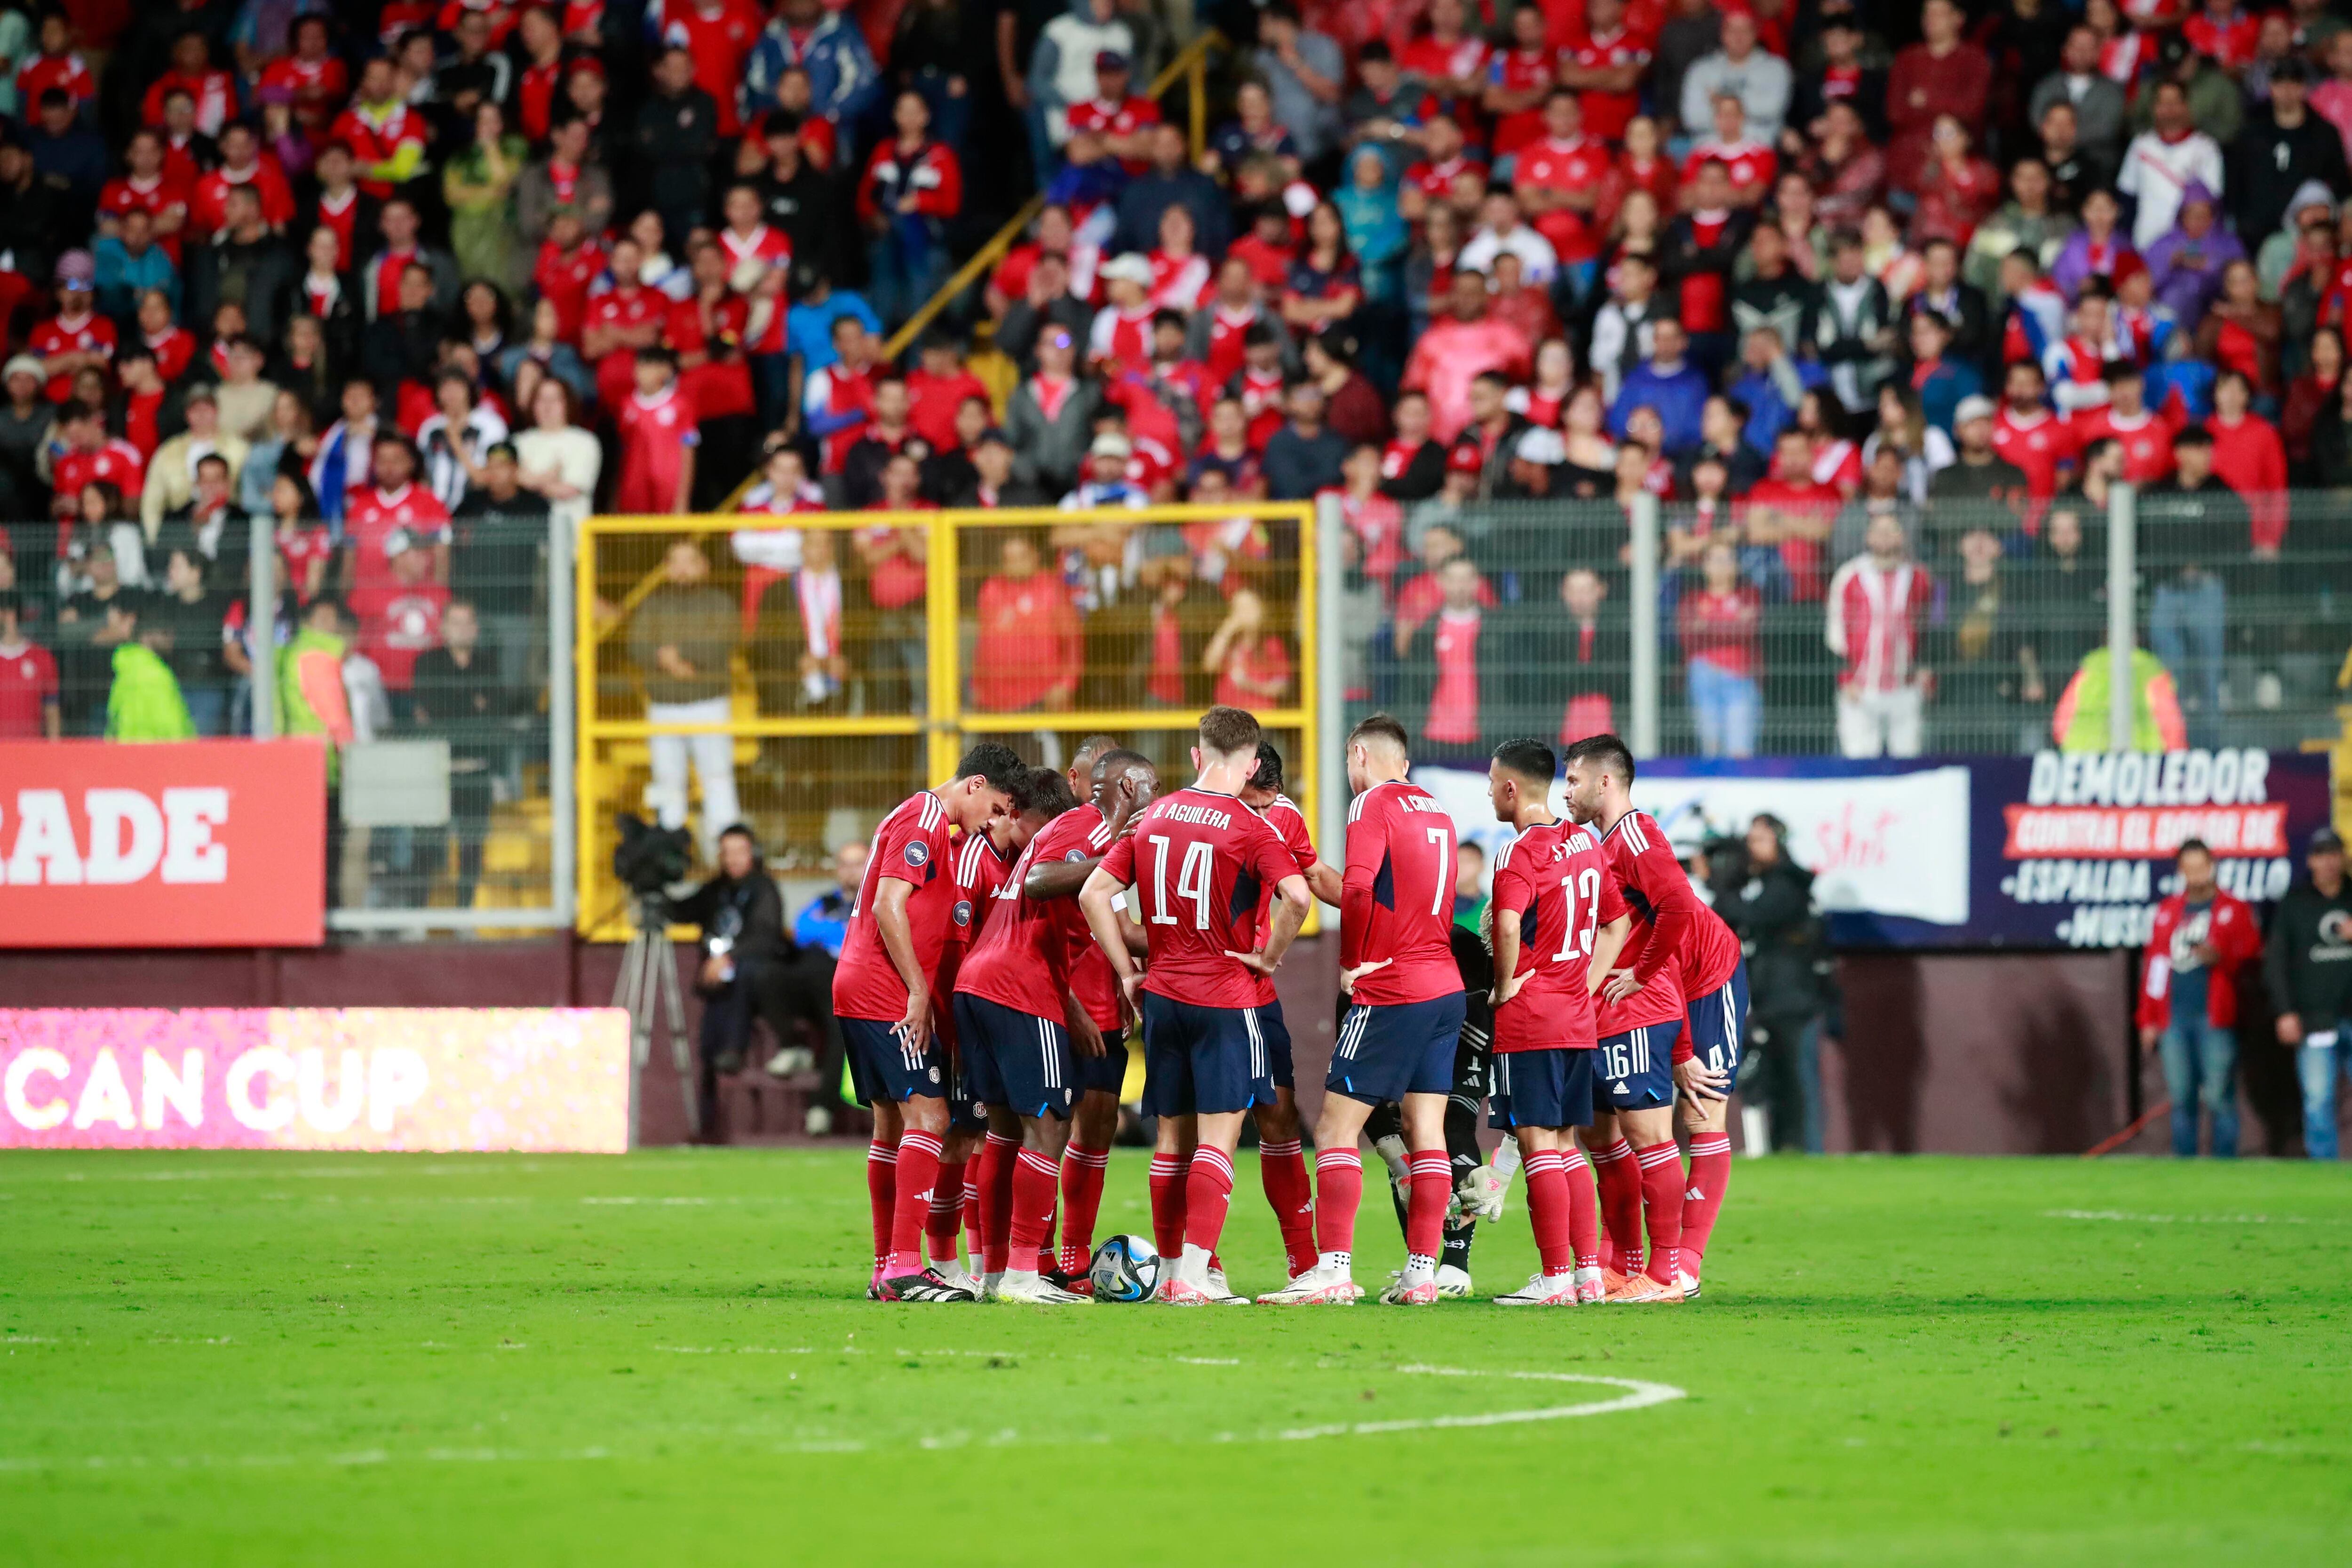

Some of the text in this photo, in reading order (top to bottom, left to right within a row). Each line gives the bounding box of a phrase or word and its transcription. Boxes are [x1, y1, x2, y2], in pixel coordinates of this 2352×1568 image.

[1152, 803, 1232, 831] B. AGUILERA
[2026, 748, 2270, 806] DEMOLEDOR
[0, 787, 229, 885] ADE
[1427, 828, 1448, 915] 7
[1148, 835, 1214, 930] 14
[1552, 868, 1600, 962] 13
[2015, 858, 2151, 903] ESPALDA
[4, 1045, 429, 1132] CAN CUP
[1603, 1044, 1629, 1080] 16
